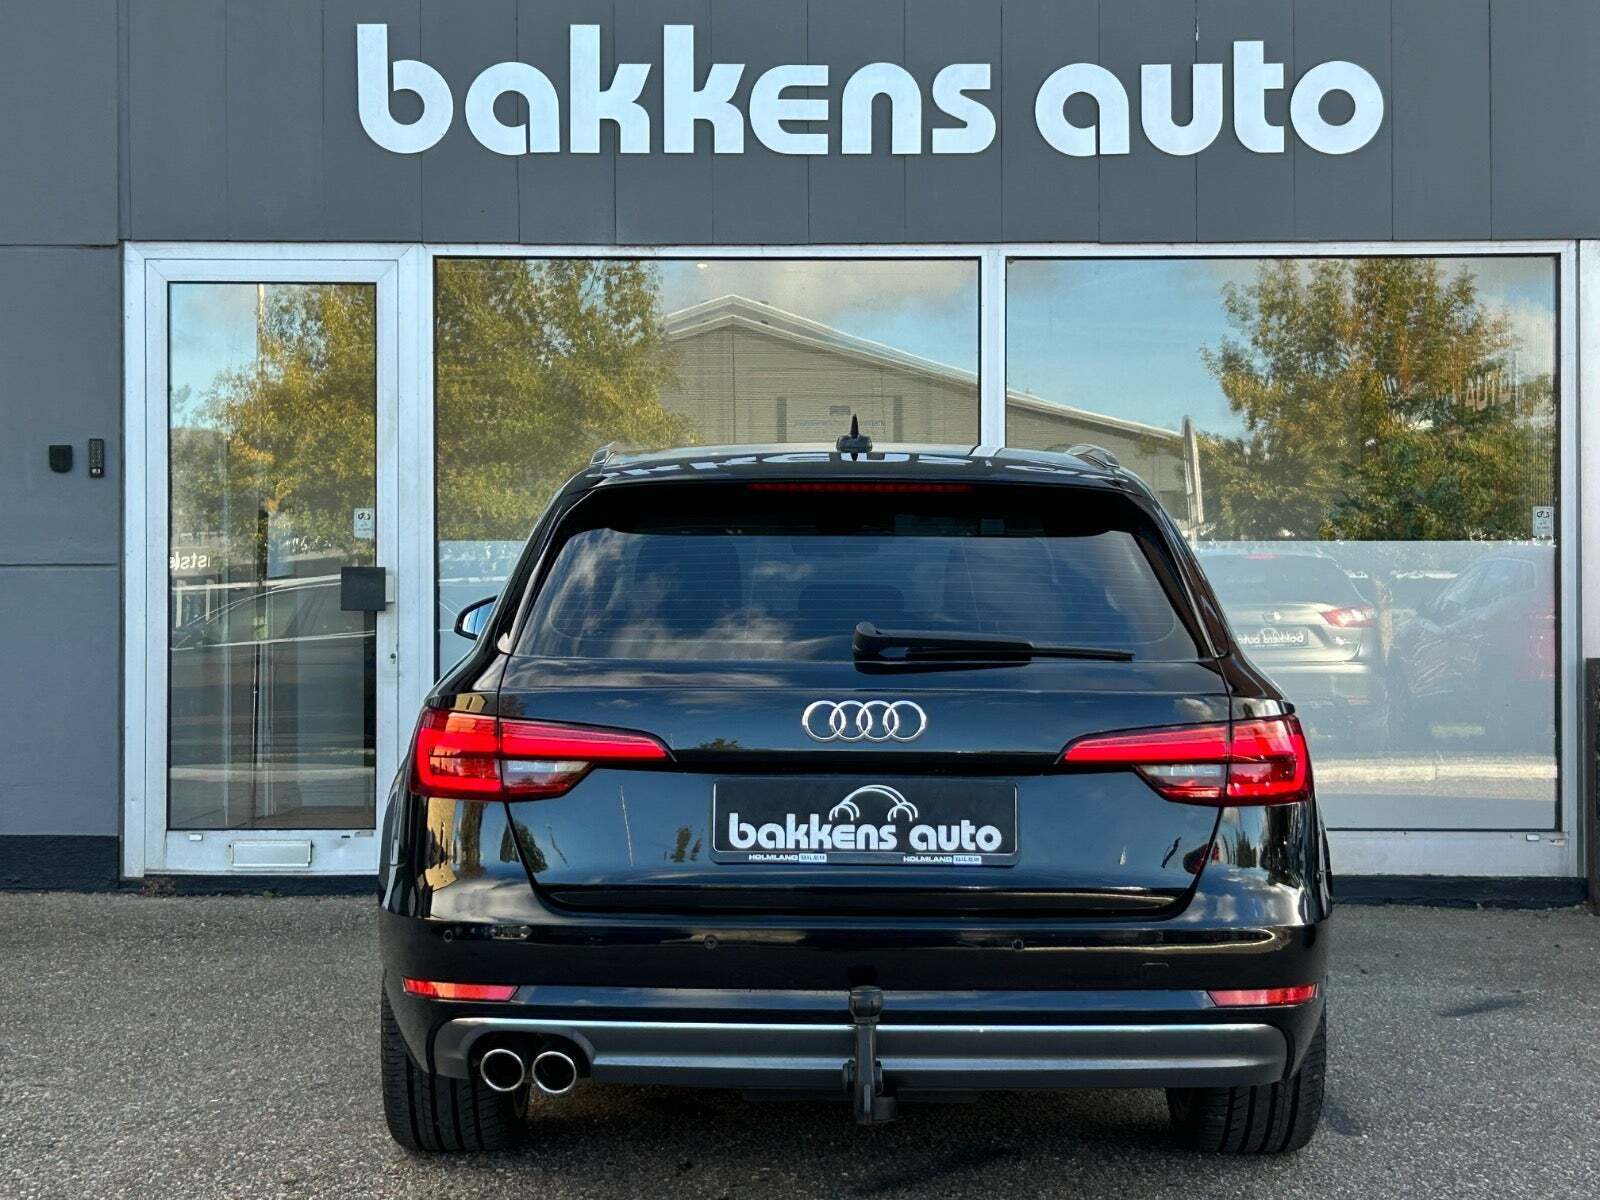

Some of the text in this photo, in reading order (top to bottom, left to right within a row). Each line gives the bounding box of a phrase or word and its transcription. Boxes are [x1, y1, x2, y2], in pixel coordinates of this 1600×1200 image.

[357, 24, 1384, 157] bakkens auto
[728, 812, 1002, 851] bakkens auto
